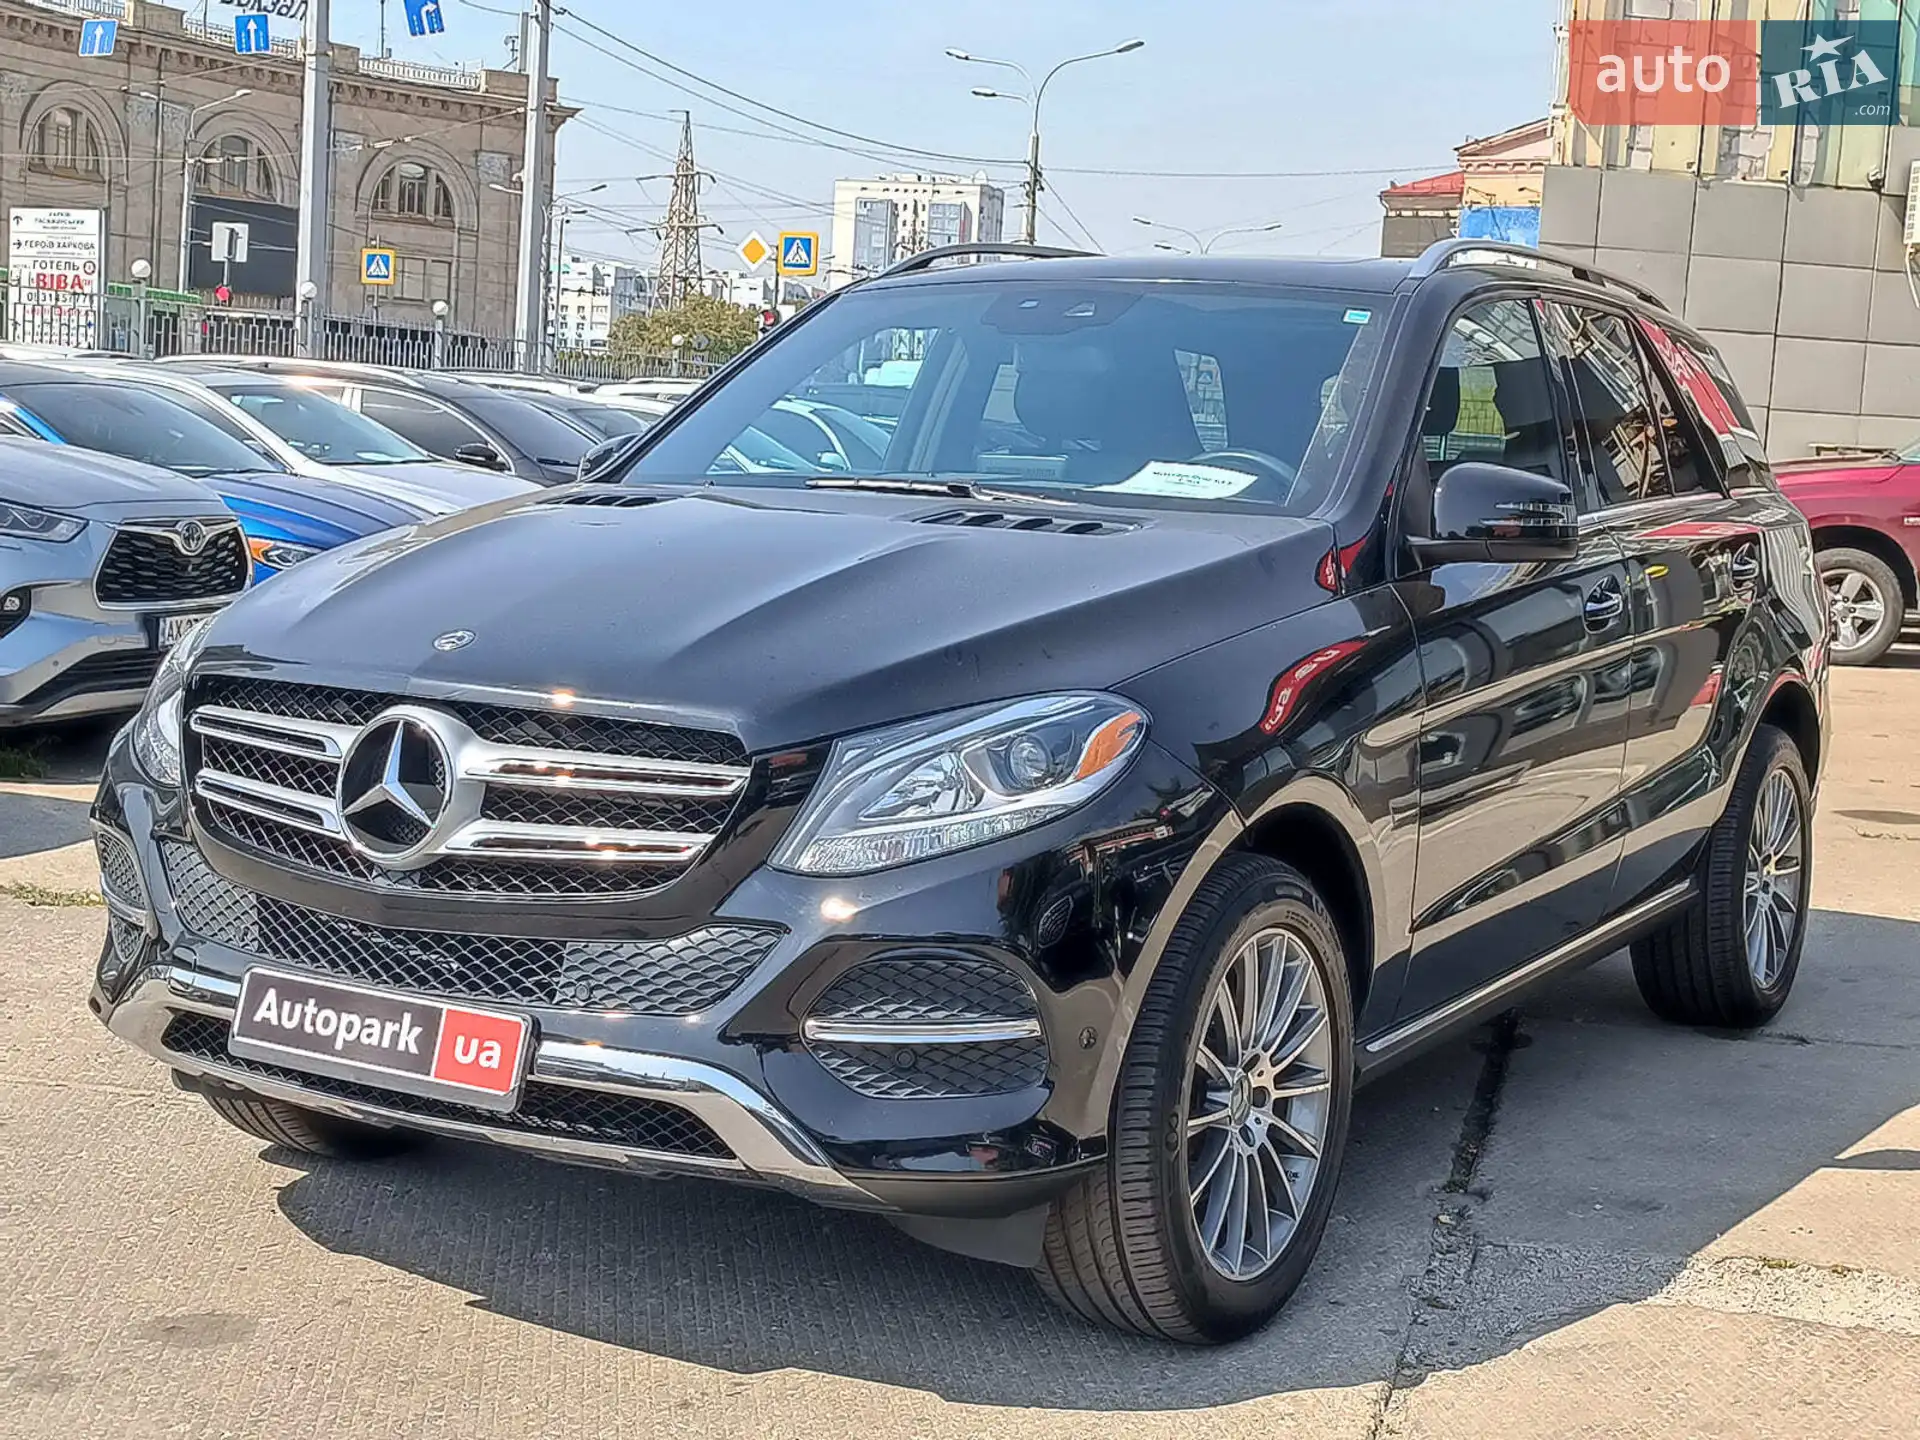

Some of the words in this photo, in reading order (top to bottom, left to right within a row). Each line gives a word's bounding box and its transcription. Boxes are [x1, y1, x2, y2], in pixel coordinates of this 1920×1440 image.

[33, 260, 80, 271] ГОТЕЛЬ
[37, 273, 83, 290] ВІВА
[254, 987, 423, 1054] Autopark
[454, 1034, 503, 1068] ua
